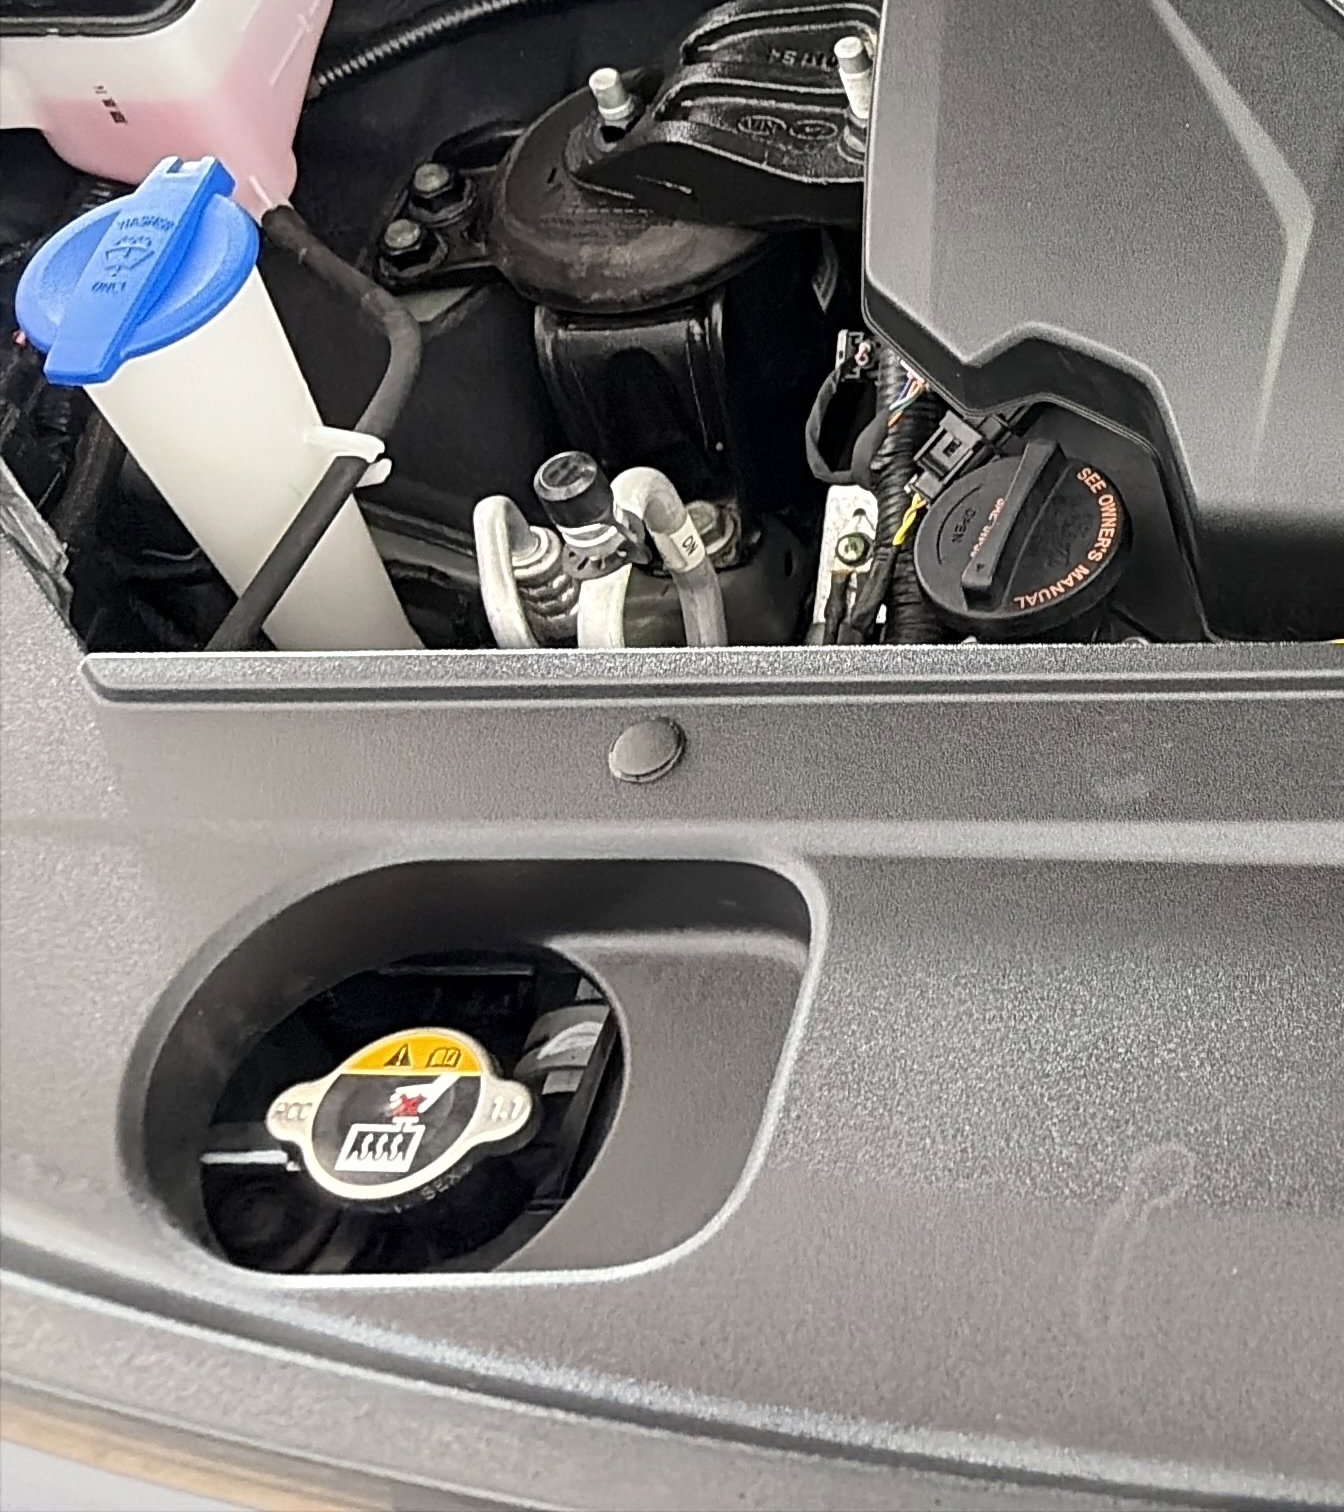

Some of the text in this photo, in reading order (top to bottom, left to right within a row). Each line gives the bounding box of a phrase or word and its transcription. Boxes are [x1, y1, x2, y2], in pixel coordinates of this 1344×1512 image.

[1013, 466, 1121, 610] SEE OWNER'S MANUAL
